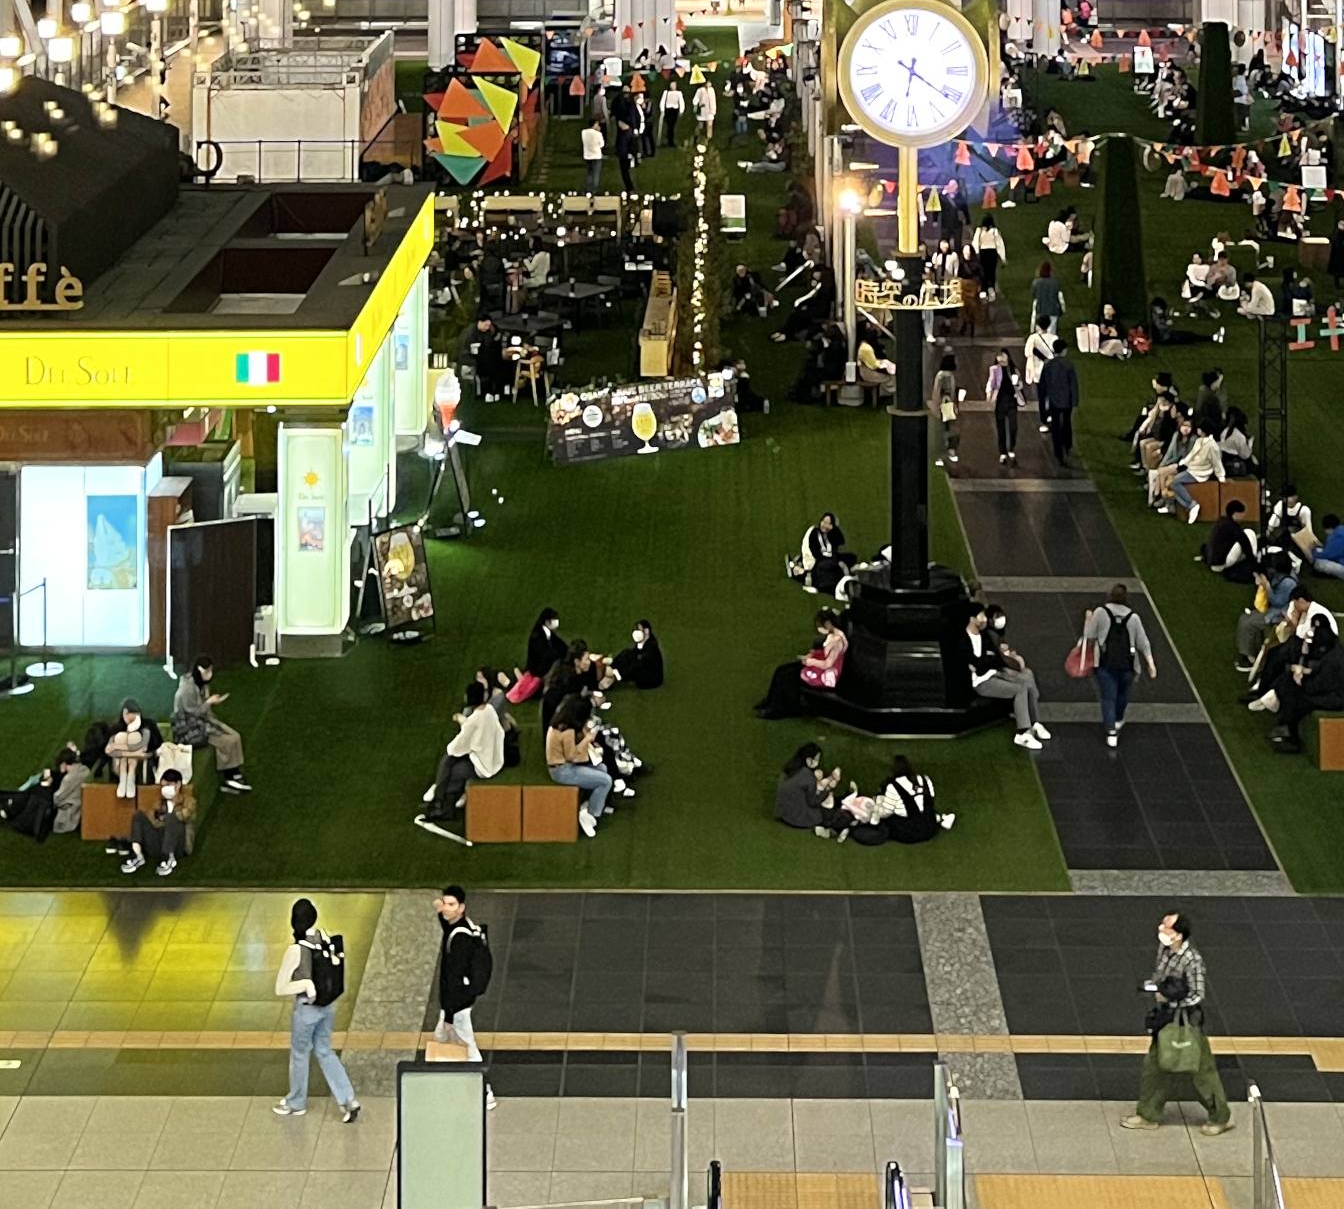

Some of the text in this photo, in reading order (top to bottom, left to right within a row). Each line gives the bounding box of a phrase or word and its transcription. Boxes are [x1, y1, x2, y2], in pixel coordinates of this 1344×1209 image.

[855, 279, 964, 307] 時空の広場
